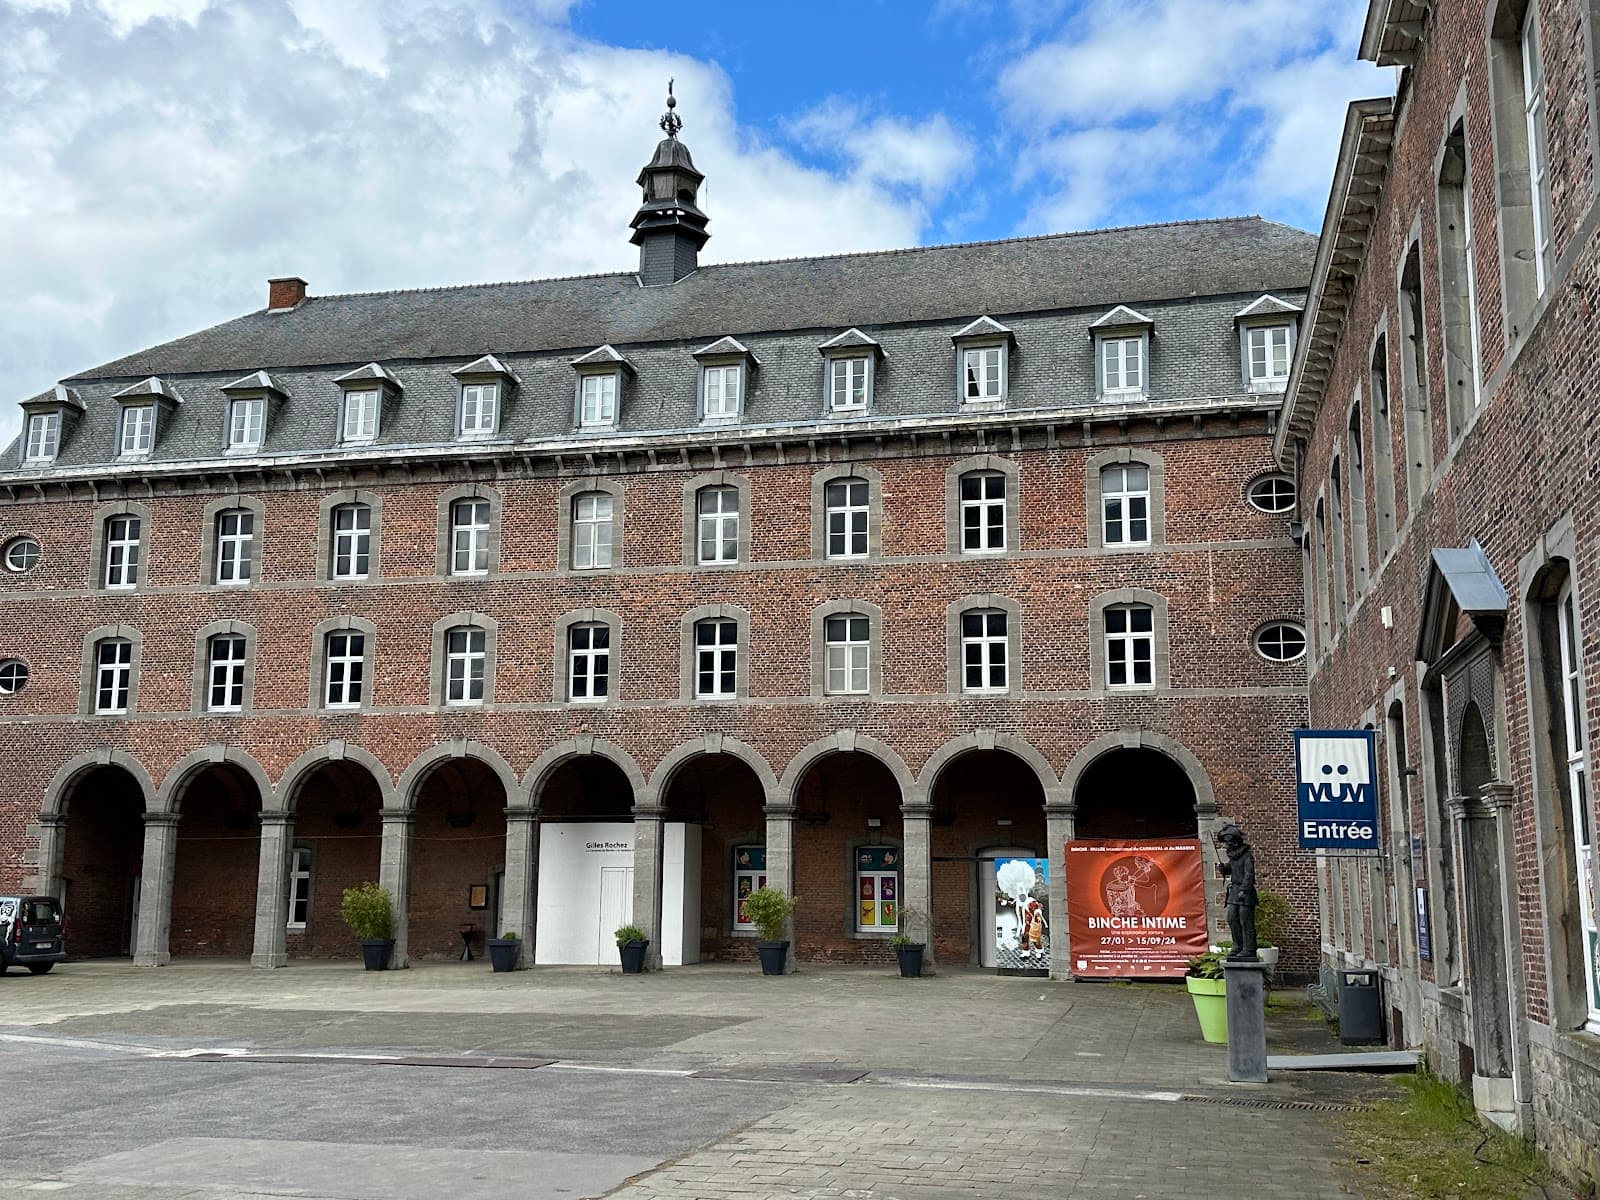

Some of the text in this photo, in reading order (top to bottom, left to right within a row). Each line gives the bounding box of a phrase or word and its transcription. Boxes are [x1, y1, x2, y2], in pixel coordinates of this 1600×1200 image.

[1303, 821, 1373, 839] Entrée
[1088, 917, 1187, 929] BINCHE INTIME
[1100, 936, 1126, 945] 27/01
[1136, 936, 1176, 945] 15/09/24
